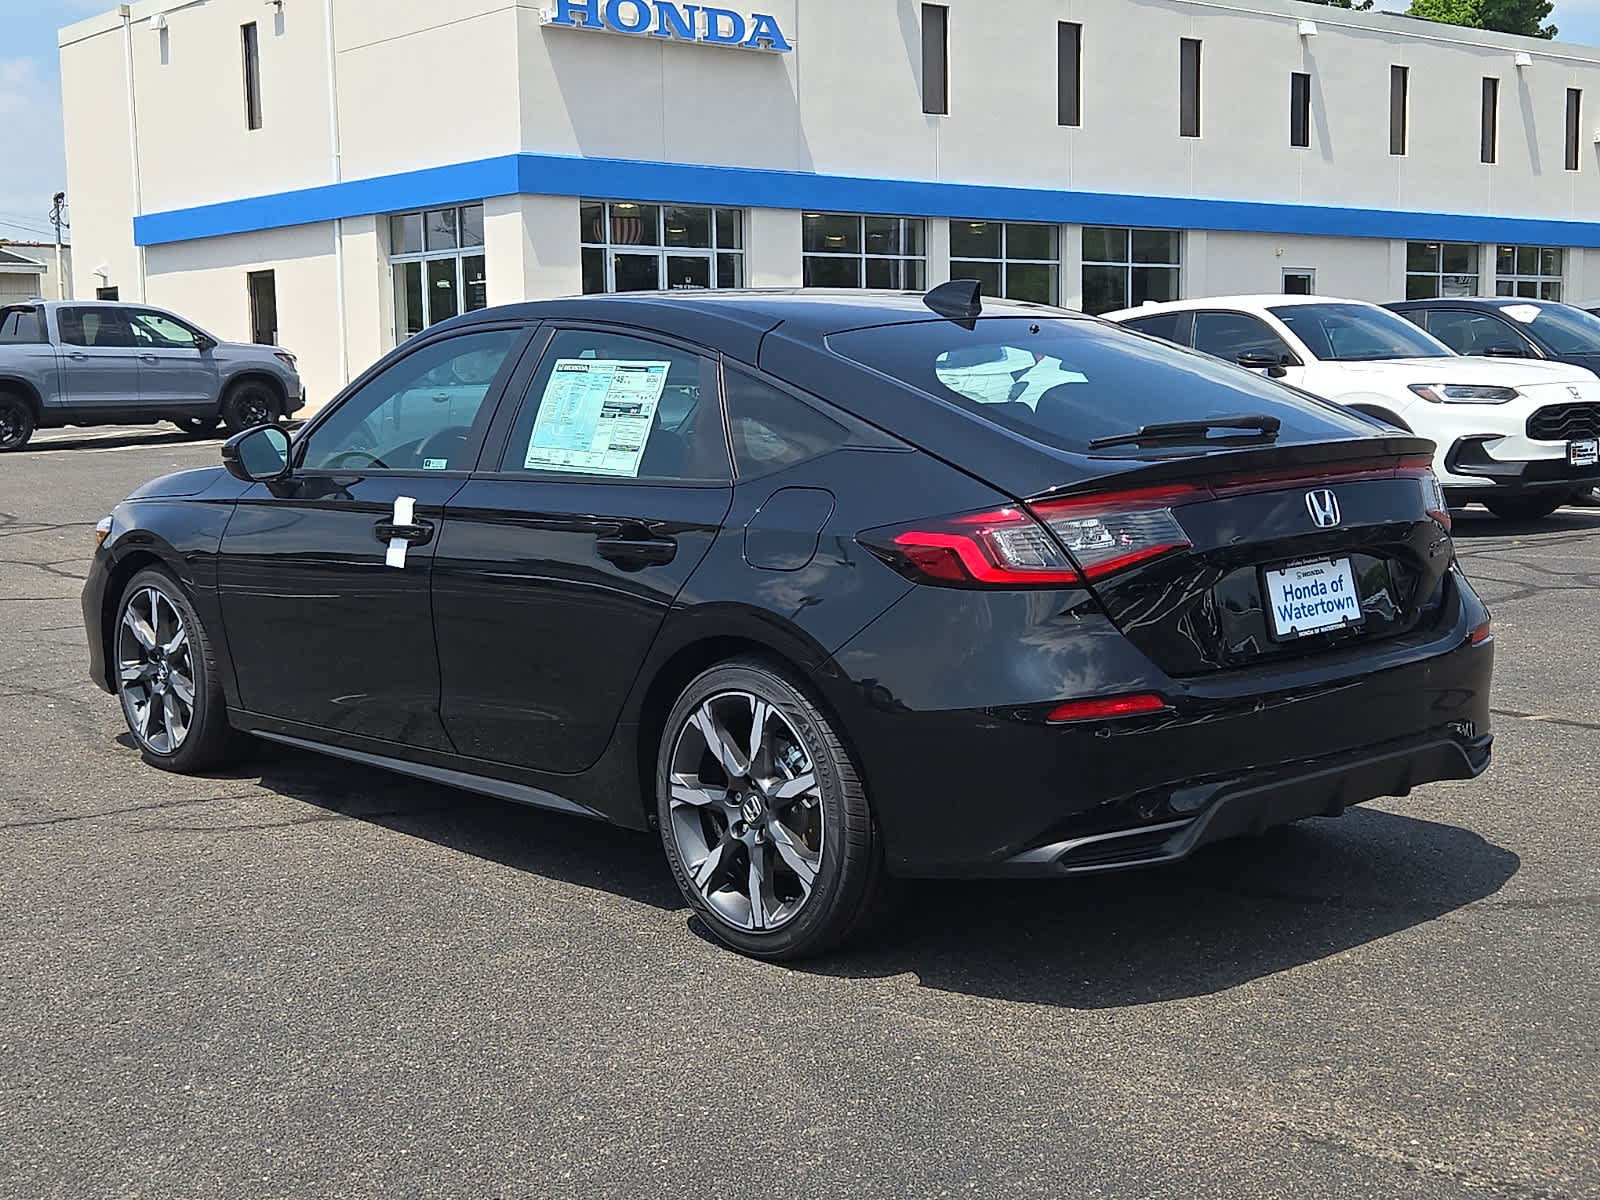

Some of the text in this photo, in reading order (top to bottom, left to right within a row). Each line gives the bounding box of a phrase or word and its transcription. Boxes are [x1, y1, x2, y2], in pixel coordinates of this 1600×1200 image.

[552, 0, 792, 51] HONDA
[1302, 568, 1325, 578] HONDA
[1282, 574, 1344, 602] Honda of
[1277, 595, 1355, 622] Watertown
